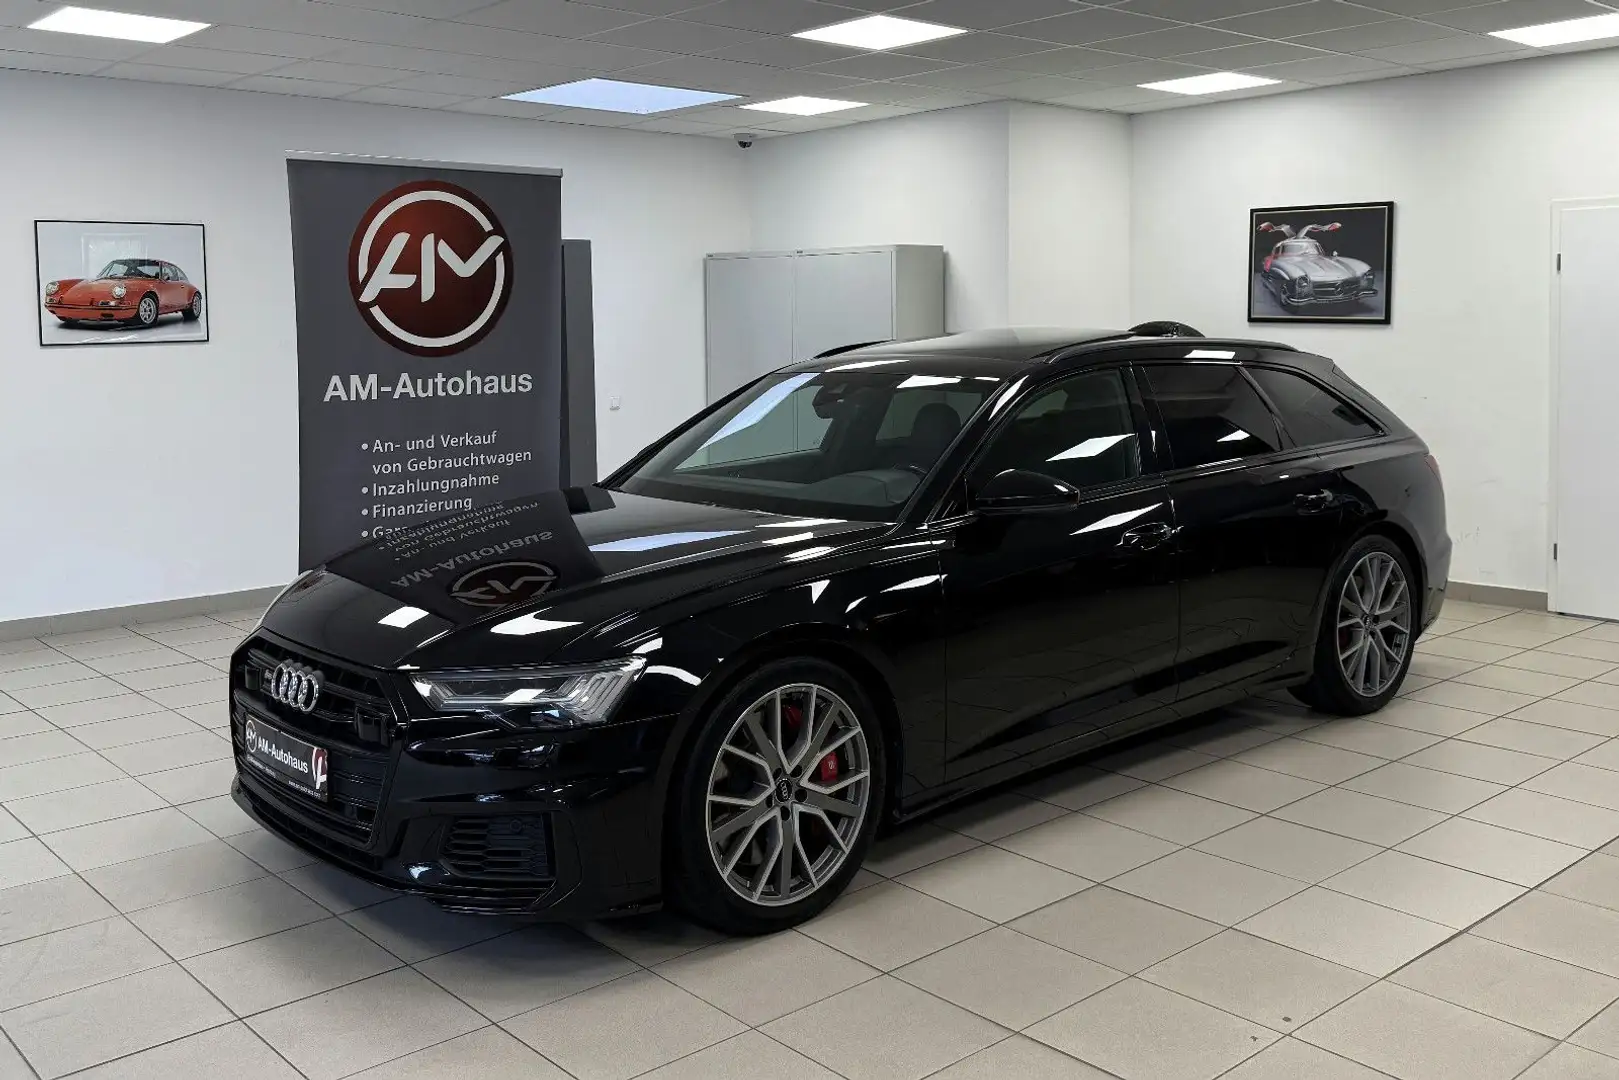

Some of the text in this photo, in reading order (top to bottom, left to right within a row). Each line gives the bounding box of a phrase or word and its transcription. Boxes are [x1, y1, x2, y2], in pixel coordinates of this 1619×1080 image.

[323, 370, 533, 402] AM-Autohaus
[372, 430, 498, 454] An- und Verkauf
[372, 449, 532, 475] von Gebrauchtwagen
[372, 472, 500, 498] Inzahlungnahme
[372, 497, 473, 520] Finanzierung
[258, 736, 309, 774] AM-Autohaus
